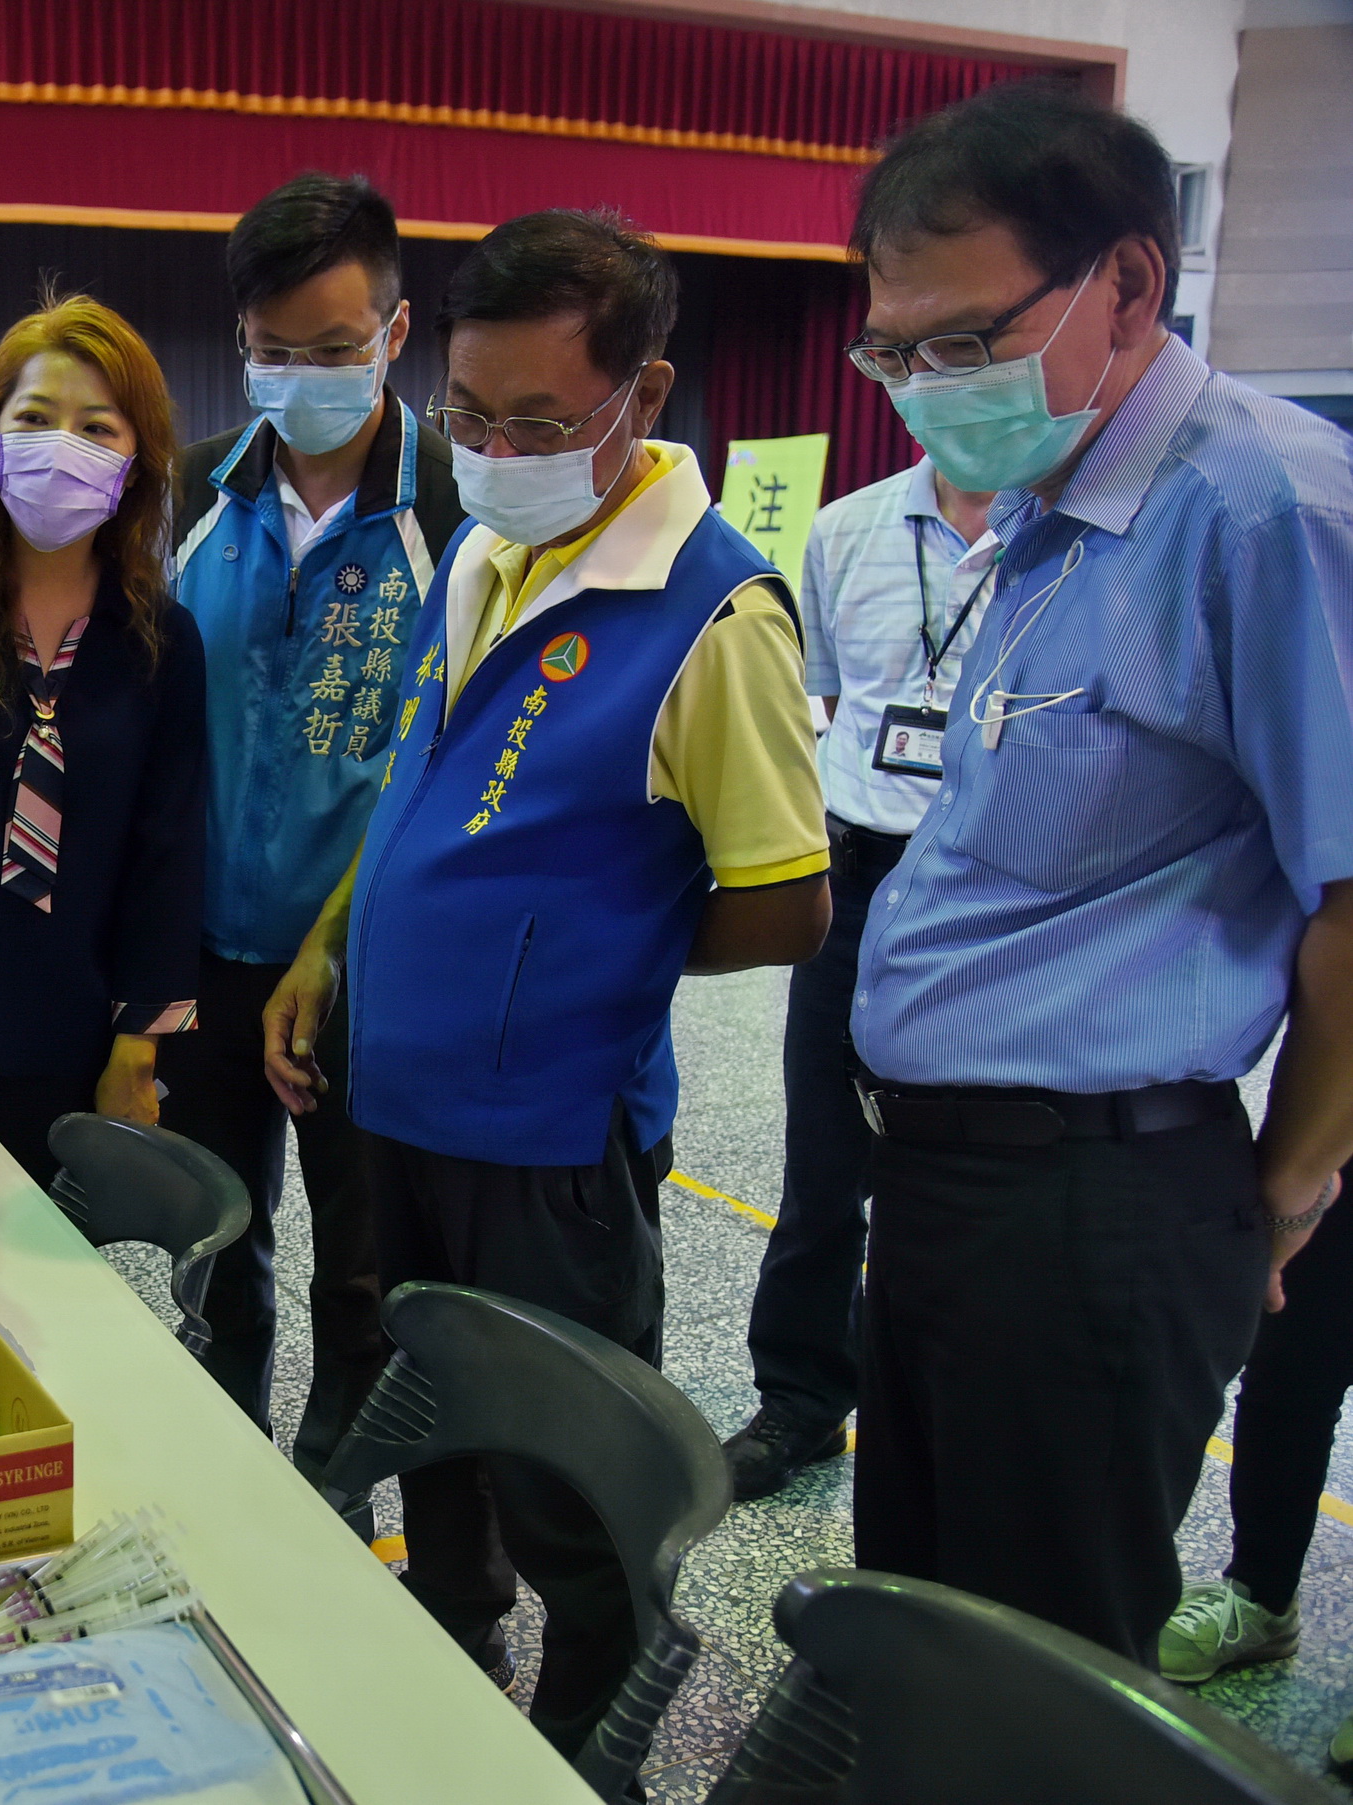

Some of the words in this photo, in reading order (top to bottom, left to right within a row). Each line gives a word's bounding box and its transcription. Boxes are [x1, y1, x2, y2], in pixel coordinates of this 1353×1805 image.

[302, 602, 362, 755] 張嘉哲
[342, 567, 408, 762] 南投縣議員
[461, 684, 548, 835] 南投縣政府
